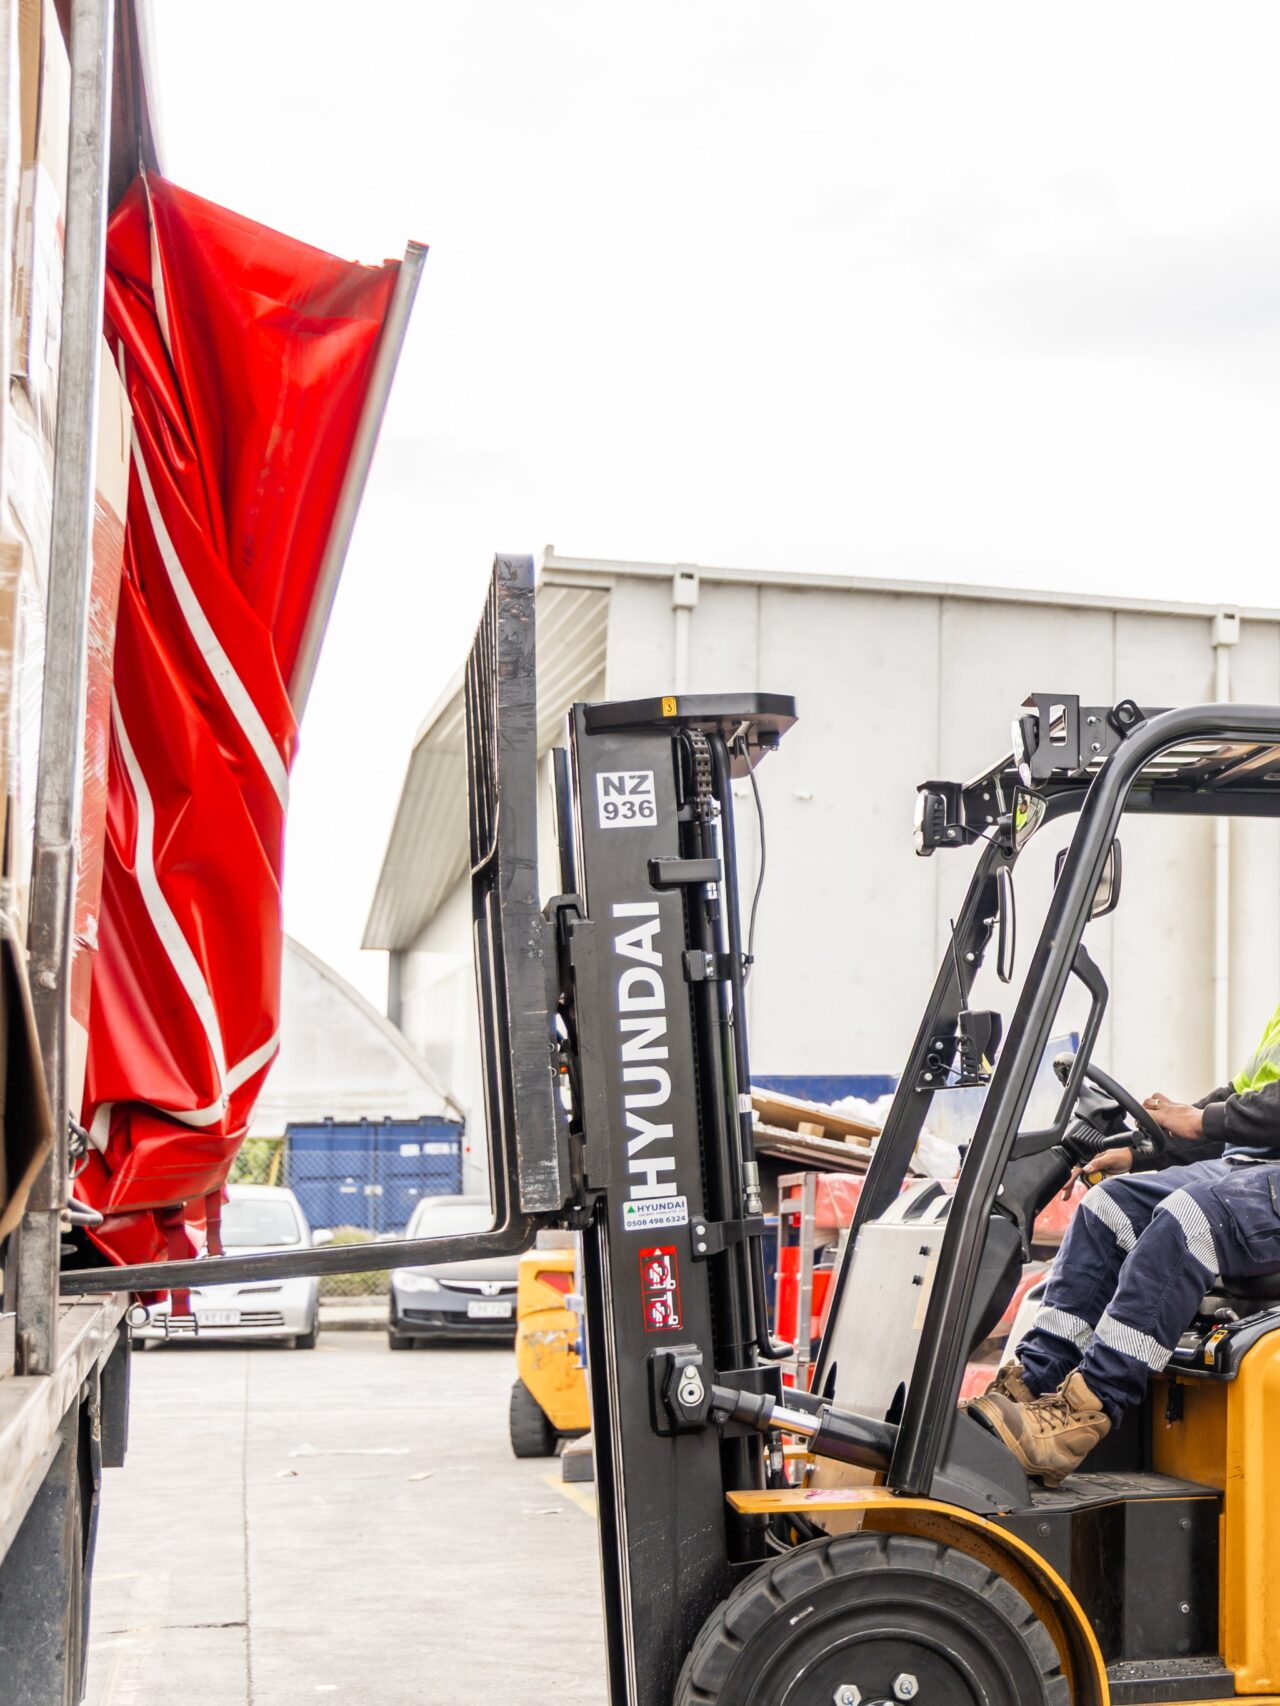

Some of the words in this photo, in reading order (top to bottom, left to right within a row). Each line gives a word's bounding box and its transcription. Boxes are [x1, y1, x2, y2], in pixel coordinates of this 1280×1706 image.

[602, 774, 651, 797] NZ
[603, 799, 655, 820] 936
[612, 902, 678, 1200] HYUNDAI
[637, 1201, 685, 1213] HYUNDAI
[626, 1219, 647, 1228] 0508
[648, 1217, 664, 1225] 498
[665, 1215, 686, 1224] 6324
